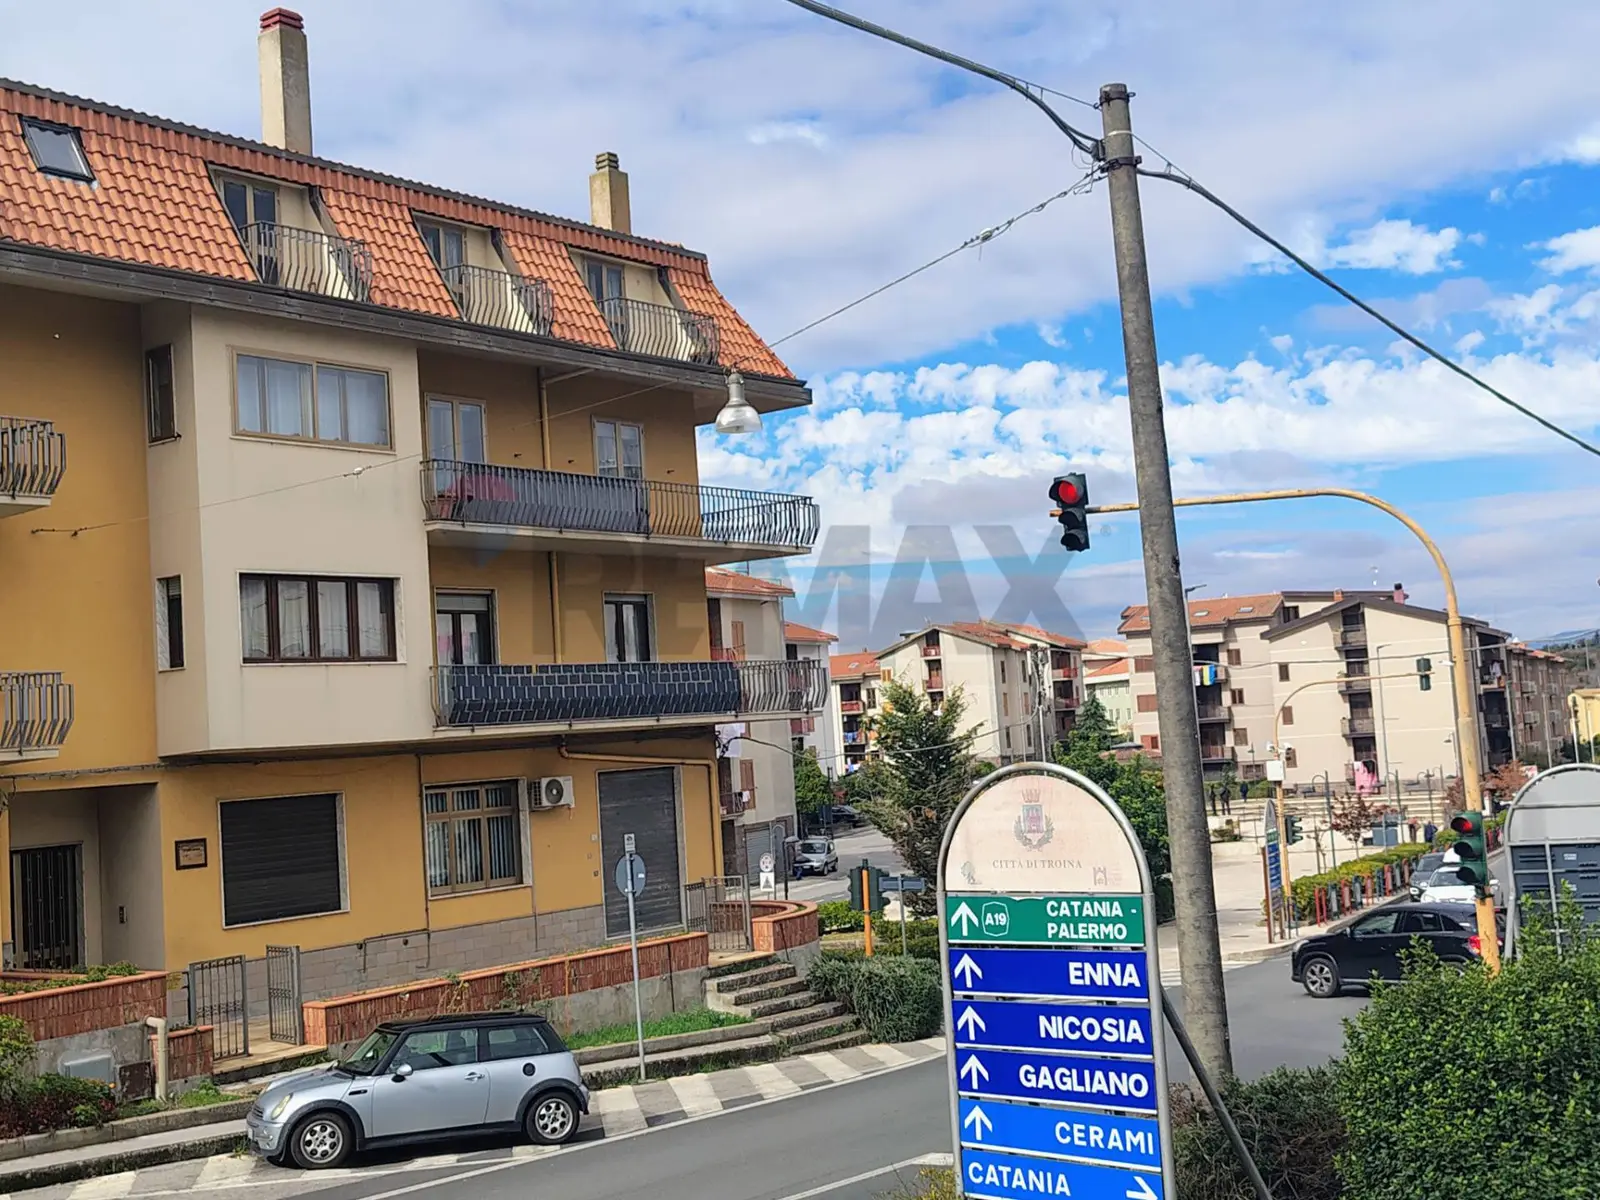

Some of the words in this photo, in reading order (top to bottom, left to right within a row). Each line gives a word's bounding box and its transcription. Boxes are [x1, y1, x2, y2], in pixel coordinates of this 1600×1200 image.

[1026, 859, 1038, 869] DI
[1040, 859, 1083, 869] TROINA
[986, 912, 1007, 926] A19
[1046, 901, 1123, 917] CATANIA
[1047, 922, 1127, 940] PALERMO
[1069, 961, 1141, 987] ENNA
[1039, 1015, 1145, 1044] NICOSIA
[1019, 1064, 1149, 1098] GAGLIANO
[1055, 1121, 1154, 1155] CERAMI
[968, 1162, 1071, 1197] CATANIA
